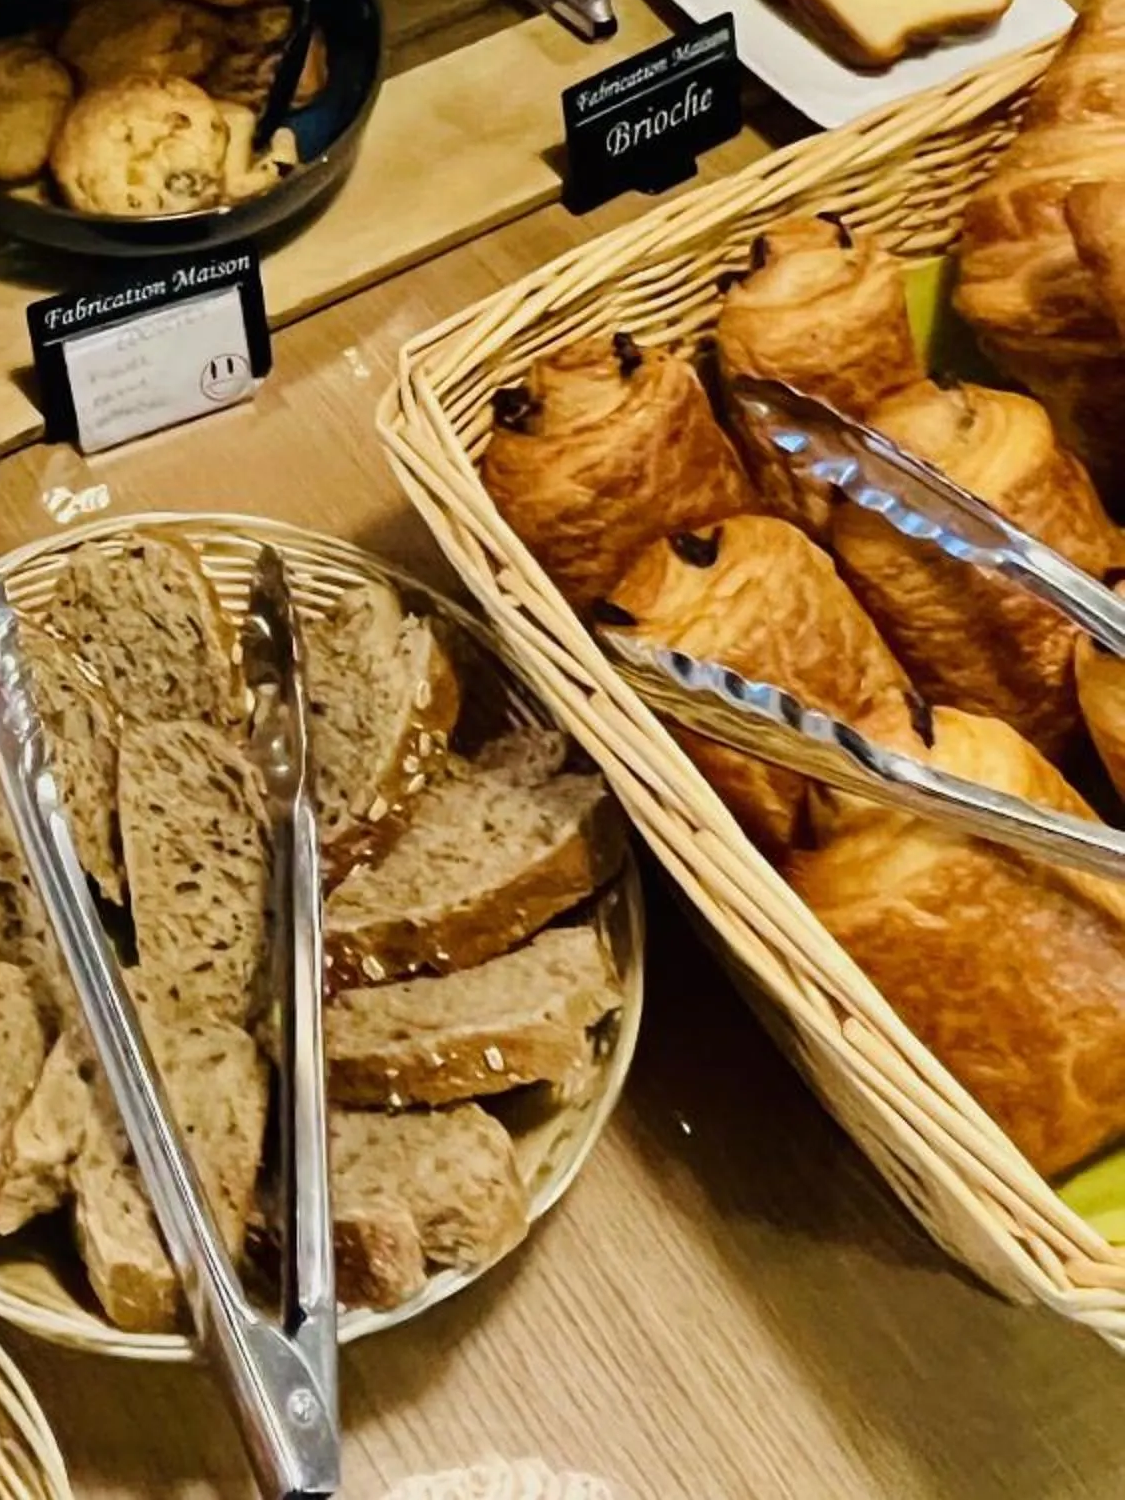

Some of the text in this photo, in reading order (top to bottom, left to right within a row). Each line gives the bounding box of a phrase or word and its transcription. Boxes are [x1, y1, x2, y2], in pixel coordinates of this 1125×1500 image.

[606, 82, 713, 157] Brioche
[44, 255, 251, 329] Fabrication Maison
